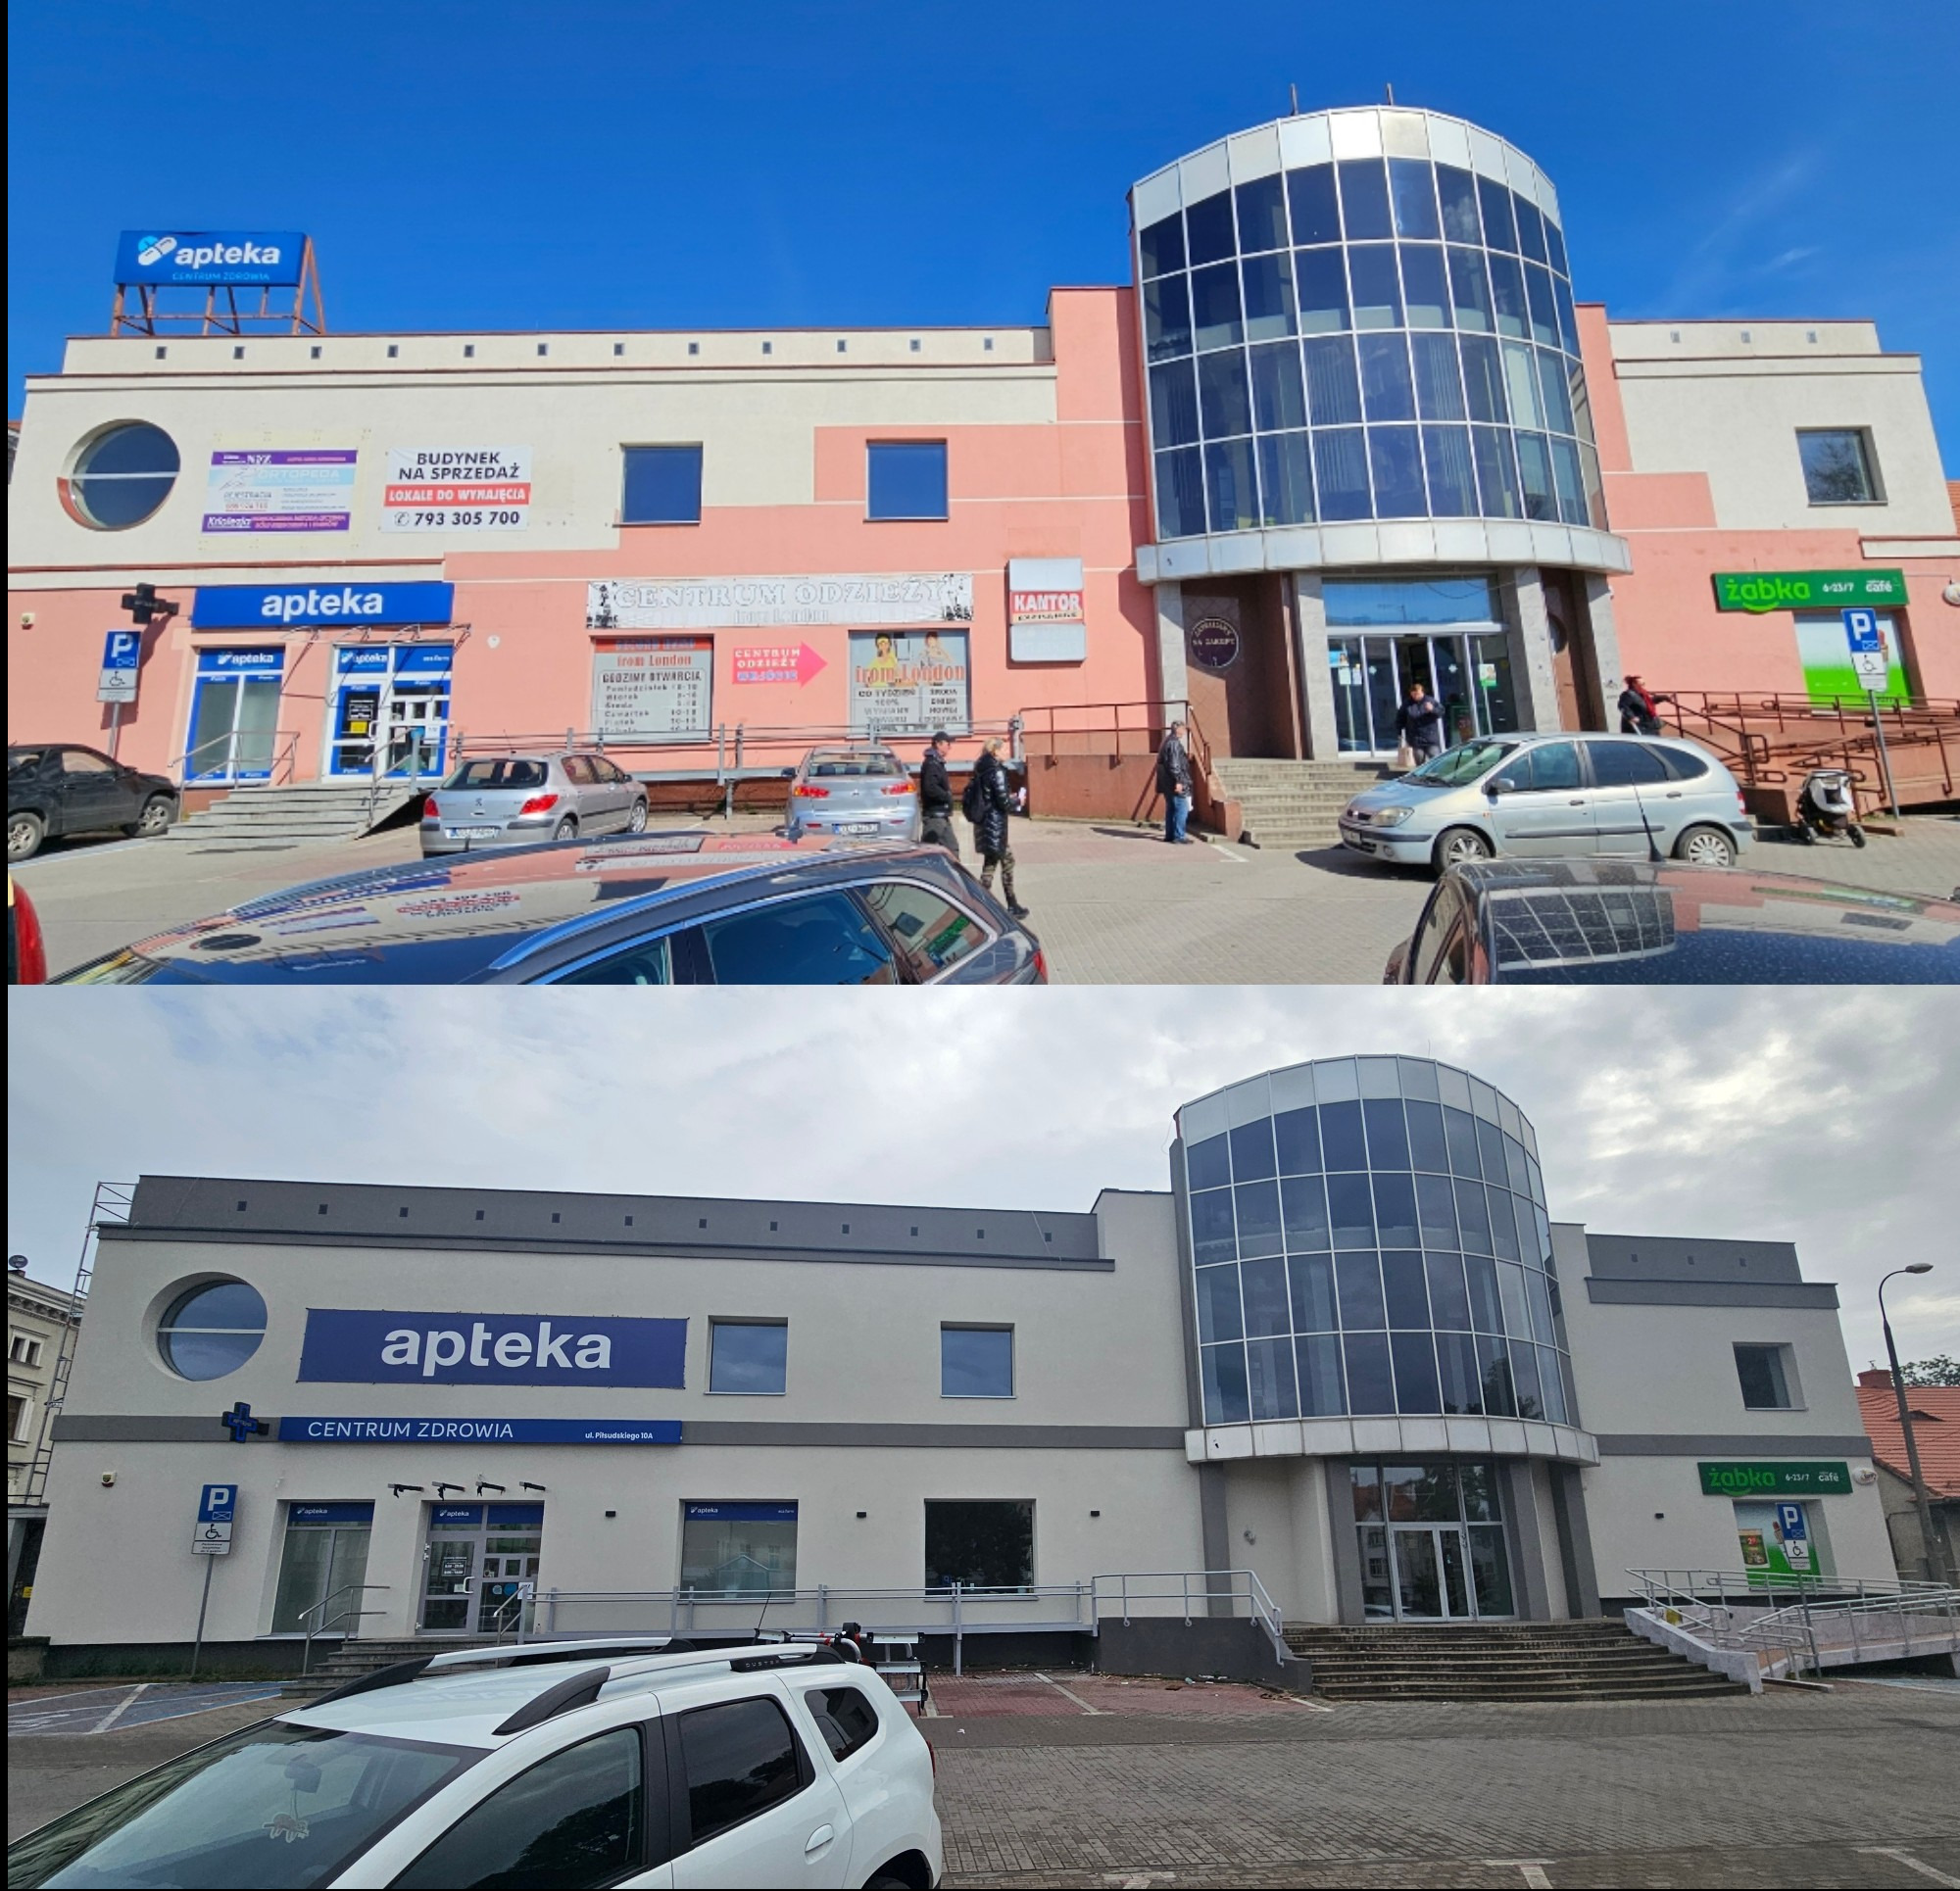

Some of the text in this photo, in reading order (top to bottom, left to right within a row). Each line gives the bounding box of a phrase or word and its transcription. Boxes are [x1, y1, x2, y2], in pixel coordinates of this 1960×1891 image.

[174, 241, 281, 269] apteka
[172, 271, 270, 281] CENTRUM ZDROWIA
[417, 452, 501, 465] BUDYNEK
[399, 462, 520, 480] NA SPRZEDAŻ
[388, 488, 526, 503] LOKALE DO WYNAJĘCIA
[415, 510, 520, 526] 793 305 700
[614, 576, 943, 608] CENTRUM ODZIEŻY
[1726, 578, 1811, 602] żabka
[261, 588, 383, 622] apteka
[1014, 593, 1082, 612] KANTOR
[1850, 612, 1871, 641] P
[111, 634, 133, 657] P
[734, 648, 801, 658] CENTRUM
[231, 653, 274, 665] apteka
[617, 655, 692, 667] from London
[603, 671, 702, 683] GODZINY OTWARCIA
[856, 663, 964, 683] from London
[381, 1322, 612, 1377] apteka
[307, 1421, 514, 1439] CENTRUM ZDROWIA
[595, 1431, 640, 1441] Piłsudskiego
[1709, 1468, 1839, 1487] żabka 6-23/7 café
[208, 1487, 229, 1511] P
[1783, 1506, 1798, 1528] P
